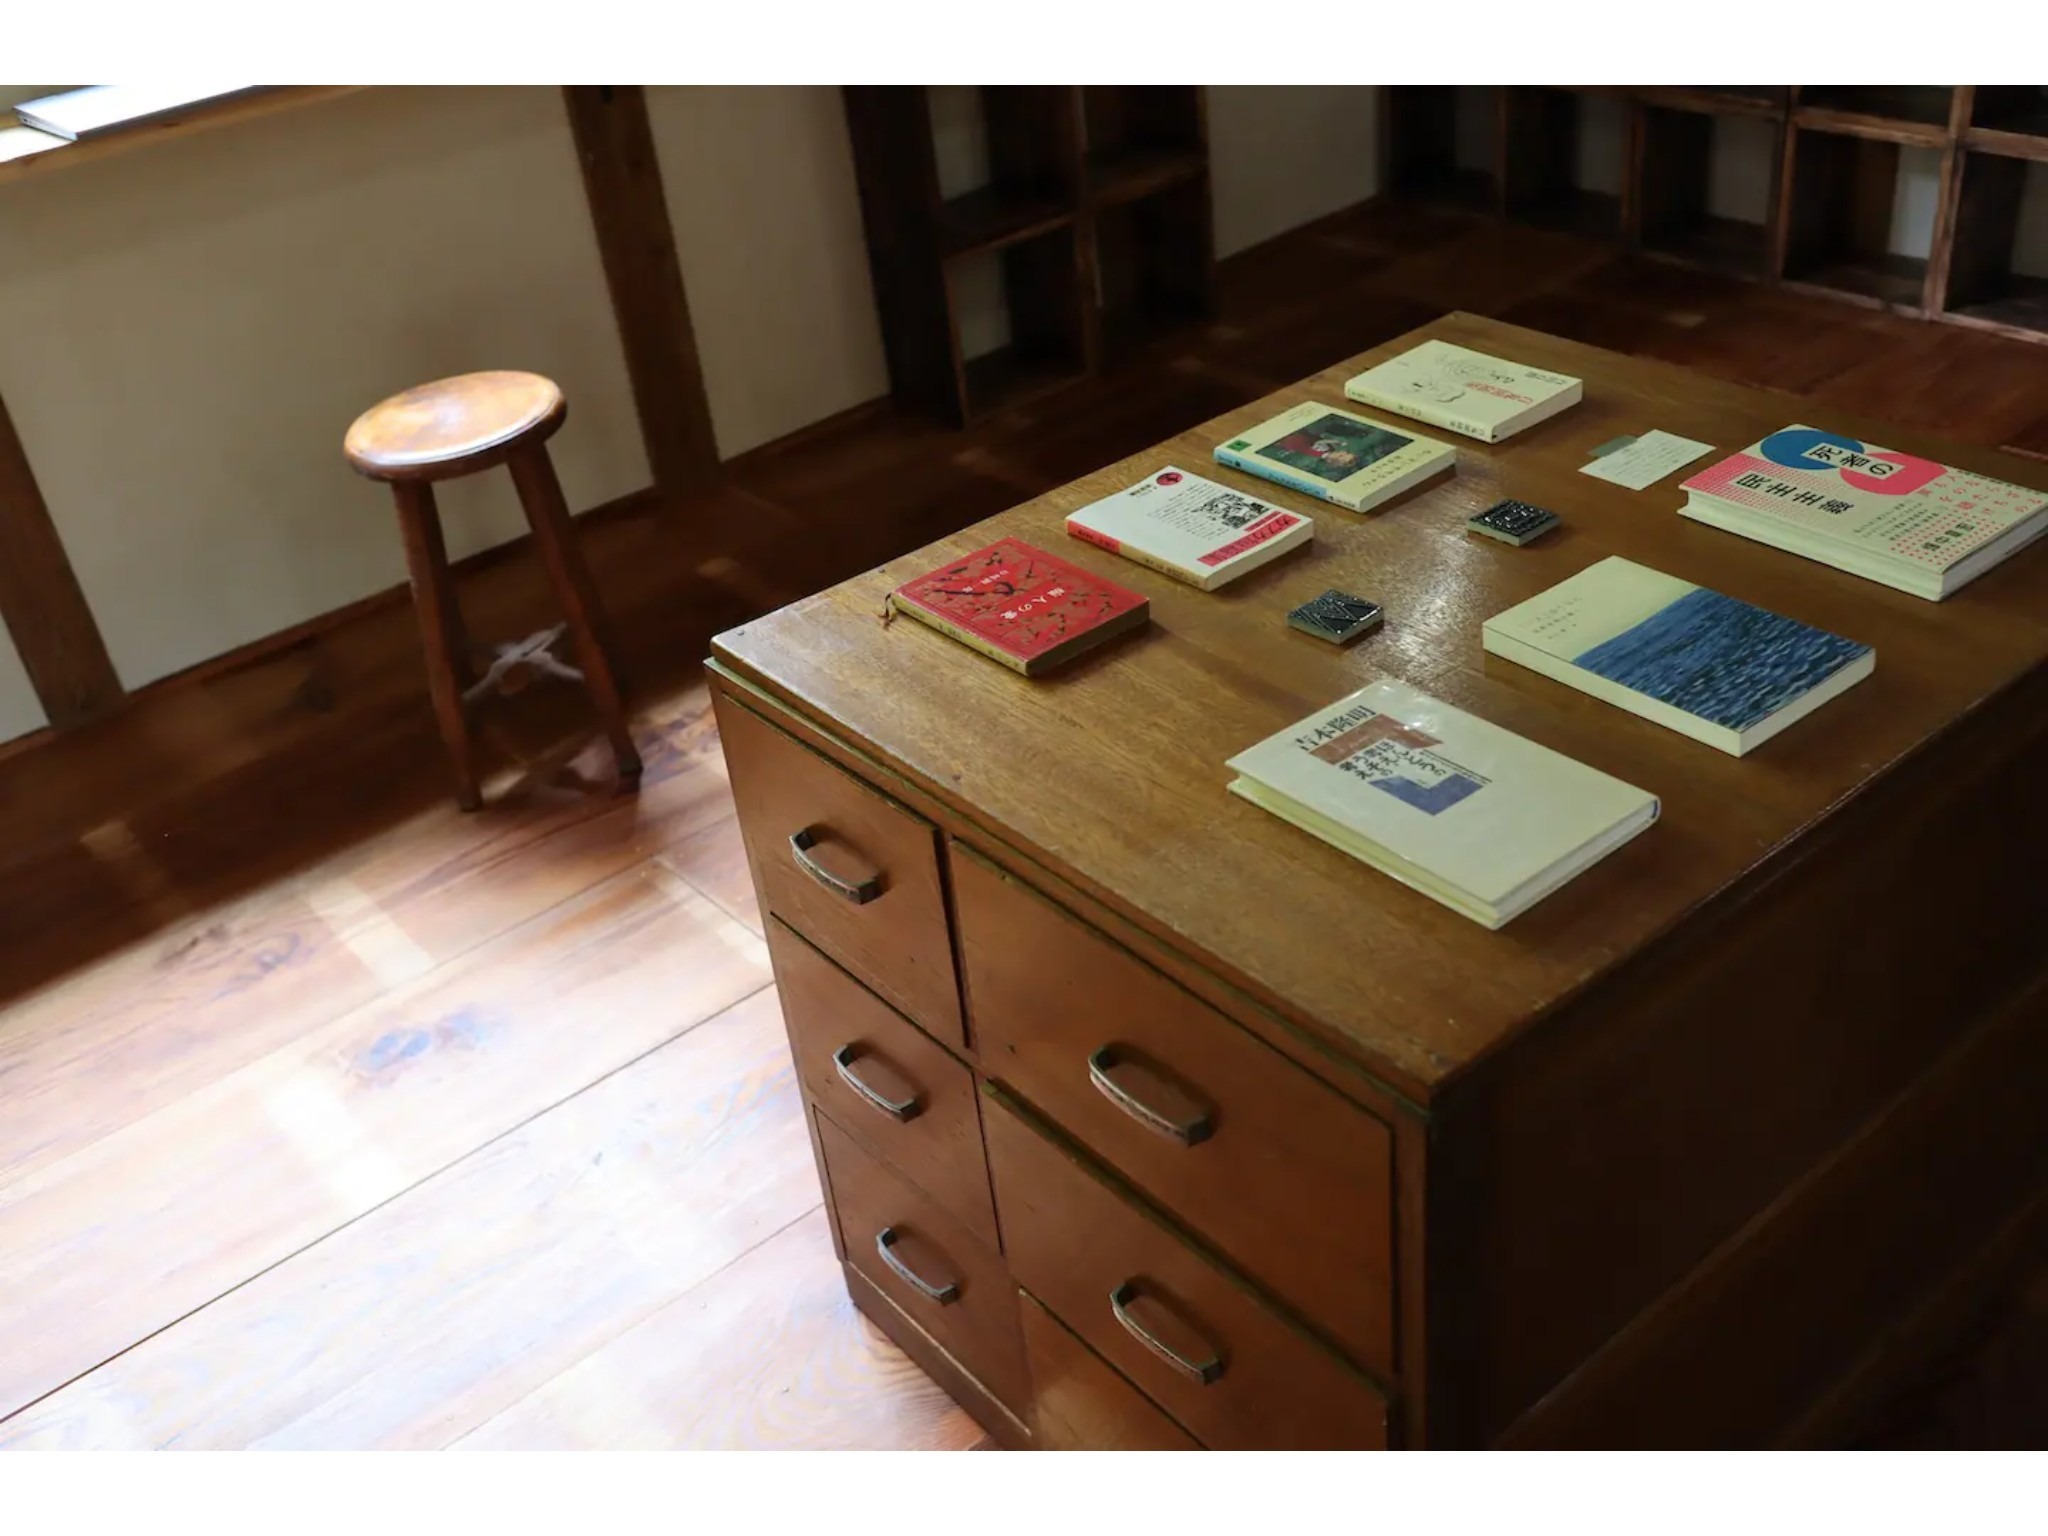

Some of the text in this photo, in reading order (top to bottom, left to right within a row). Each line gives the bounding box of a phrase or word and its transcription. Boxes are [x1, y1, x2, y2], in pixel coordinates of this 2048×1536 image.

[1808, 444, 1894, 476] 死者の
[1736, 473, 1854, 514] 民主主義
[1295, 705, 1377, 751] 吉本隆明
[1338, 760, 1374, 781] 考え
[1353, 754, 1394, 778] うその
[1374, 740, 1447, 777] ほんとうの
